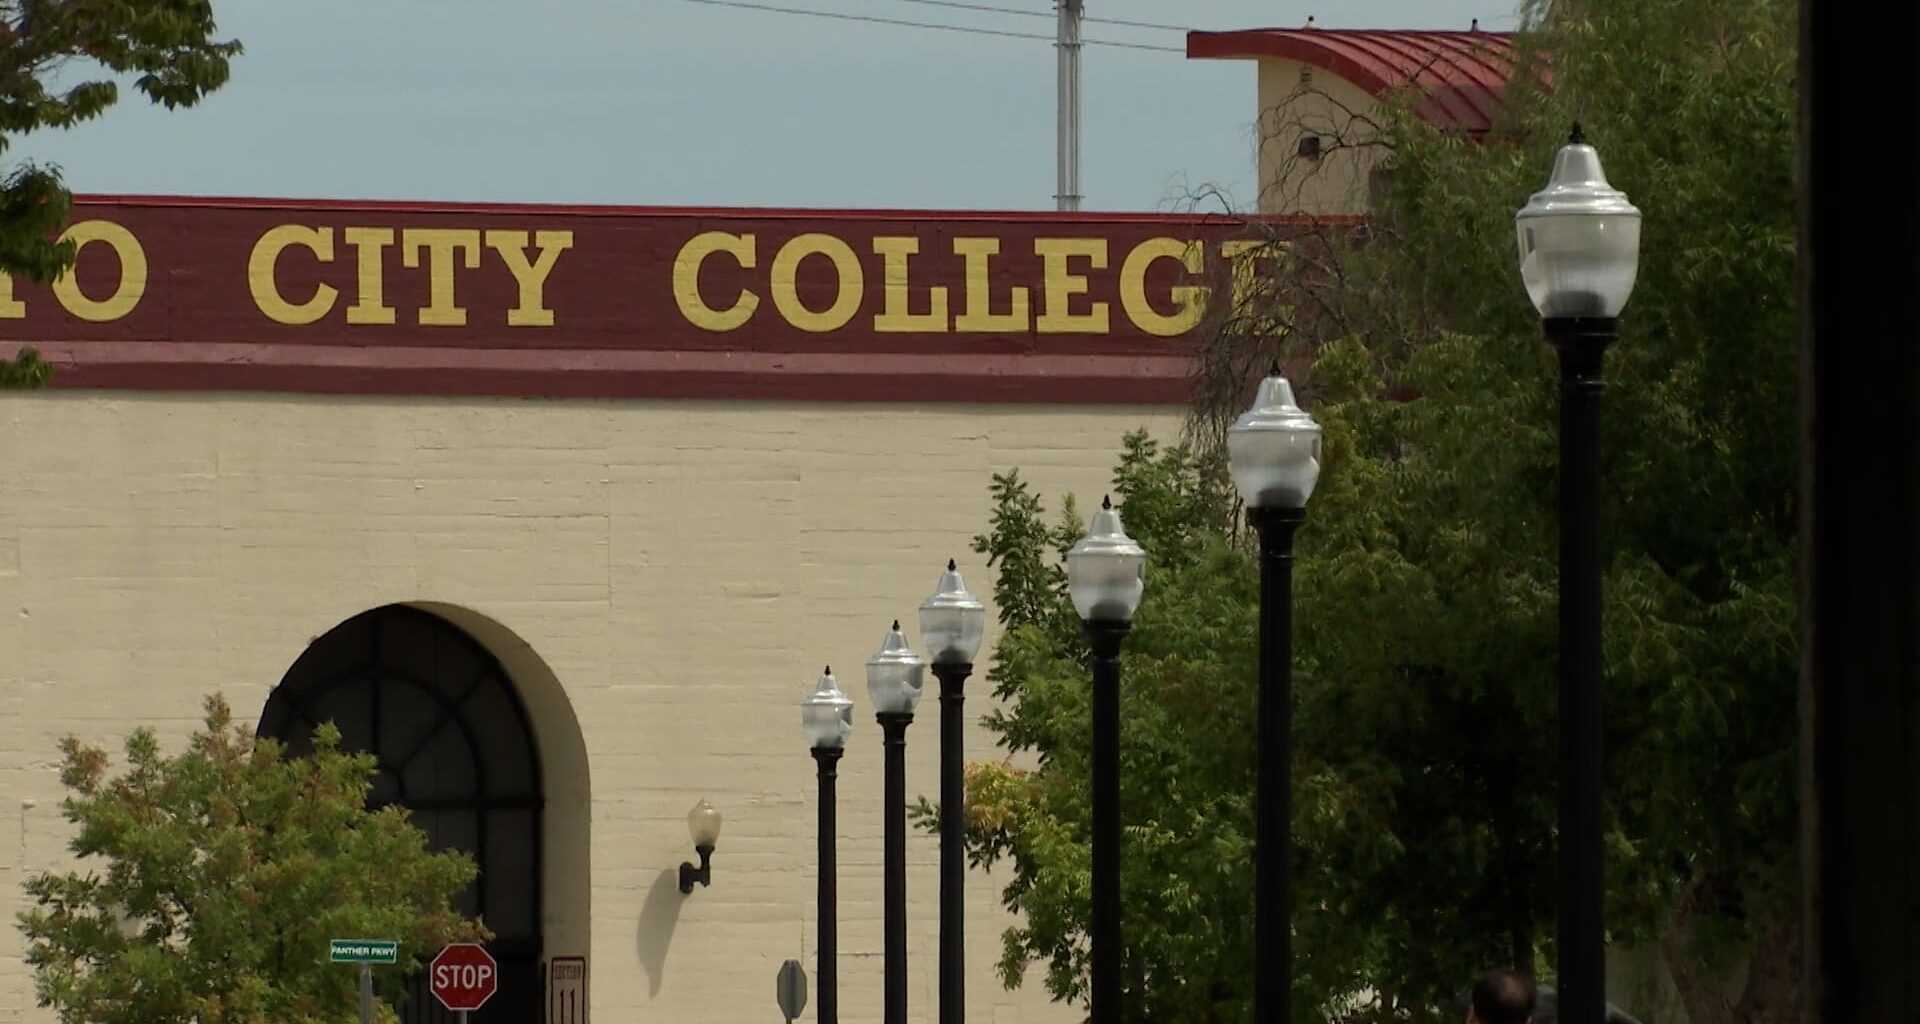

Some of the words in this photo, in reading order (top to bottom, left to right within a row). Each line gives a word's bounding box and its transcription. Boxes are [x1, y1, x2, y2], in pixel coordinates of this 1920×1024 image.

[0, 220, 148, 322] O
[248, 224, 574, 327] CITY
[672, 231, 1294, 337] COLLEGE
[331, 945, 369, 956] PANTHER
[371, 947, 394, 957] PKWY
[435, 964, 492, 989] STOP
